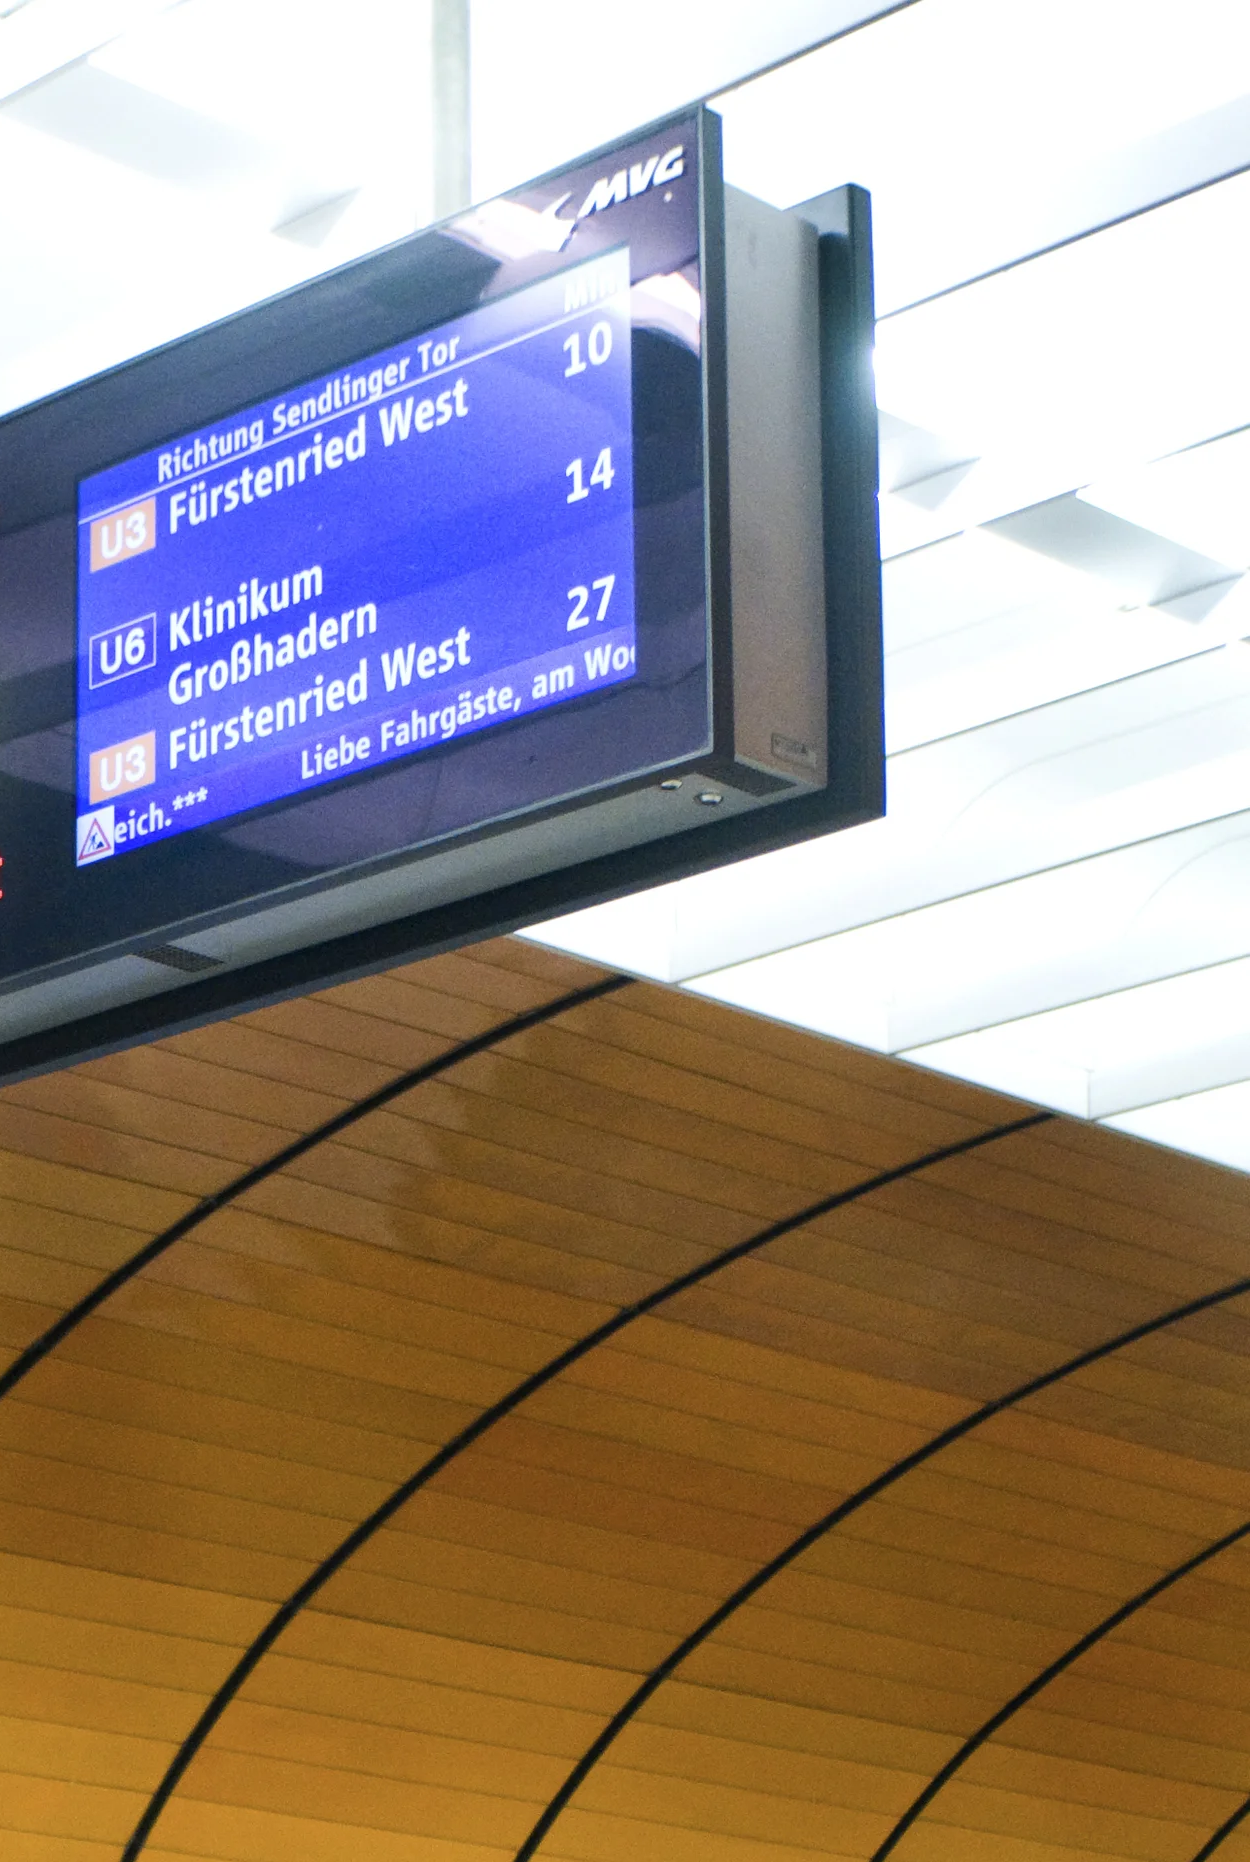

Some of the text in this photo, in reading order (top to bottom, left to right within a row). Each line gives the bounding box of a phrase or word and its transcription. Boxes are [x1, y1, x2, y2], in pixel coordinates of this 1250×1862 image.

[577, 144, 685, 219] MVG
[101, 321, 612, 560] U3 Fürstenried West 10
[157, 336, 460, 484] Richtung Sendlinger Tor
[101, 447, 615, 675] U6 Klinikum 14
[101, 575, 616, 792] U3 Fürstenried West 27
[168, 602, 377, 705] Großhadern
[301, 734, 370, 780] Liebe
[381, 683, 521, 753] Fahrgäste,
[532, 667, 574, 701] am
